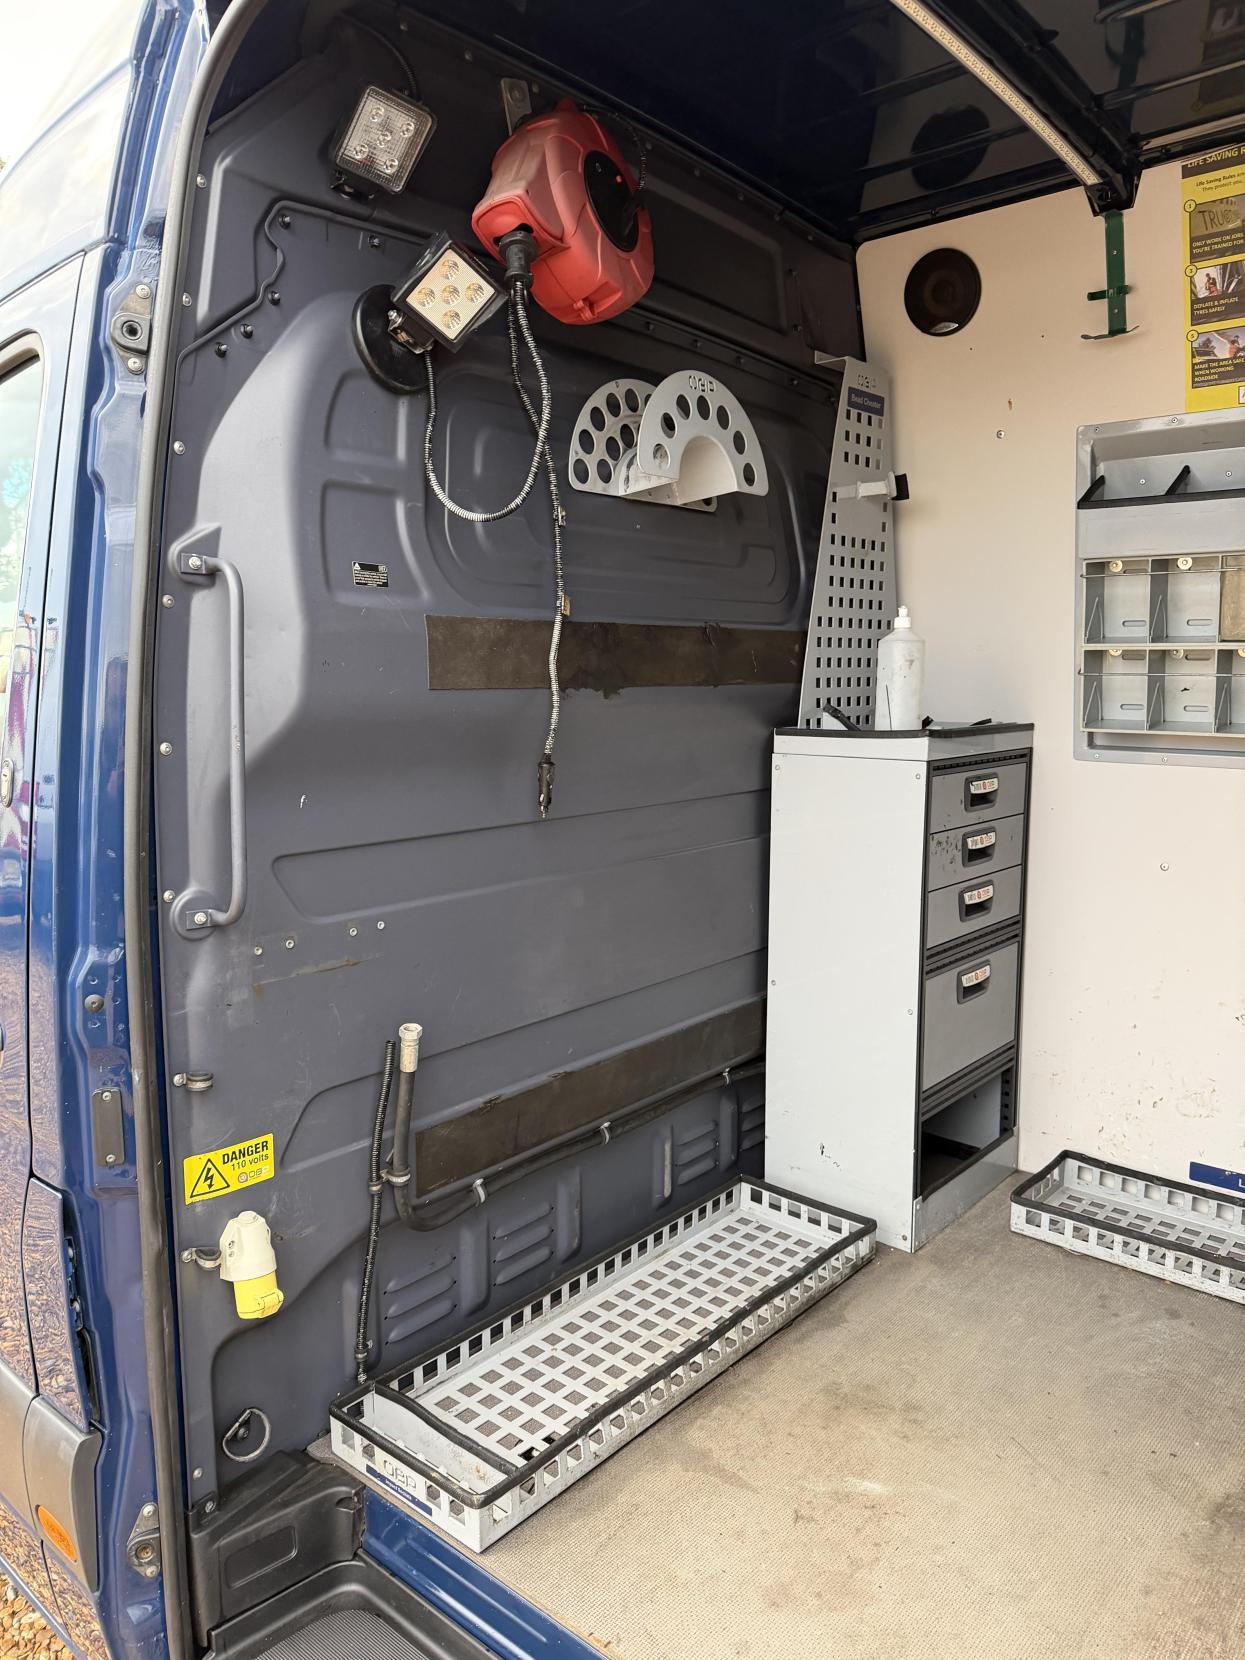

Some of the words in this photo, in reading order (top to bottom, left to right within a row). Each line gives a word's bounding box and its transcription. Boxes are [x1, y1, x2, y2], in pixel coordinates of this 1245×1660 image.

[1206, 148, 1239, 163] SAVING
[1205, 237, 1221, 245] WORK
[222, 1140, 269, 1165] DANGER
[232, 1160, 247, 1171] 110
[248, 1153, 270, 1166] volts
